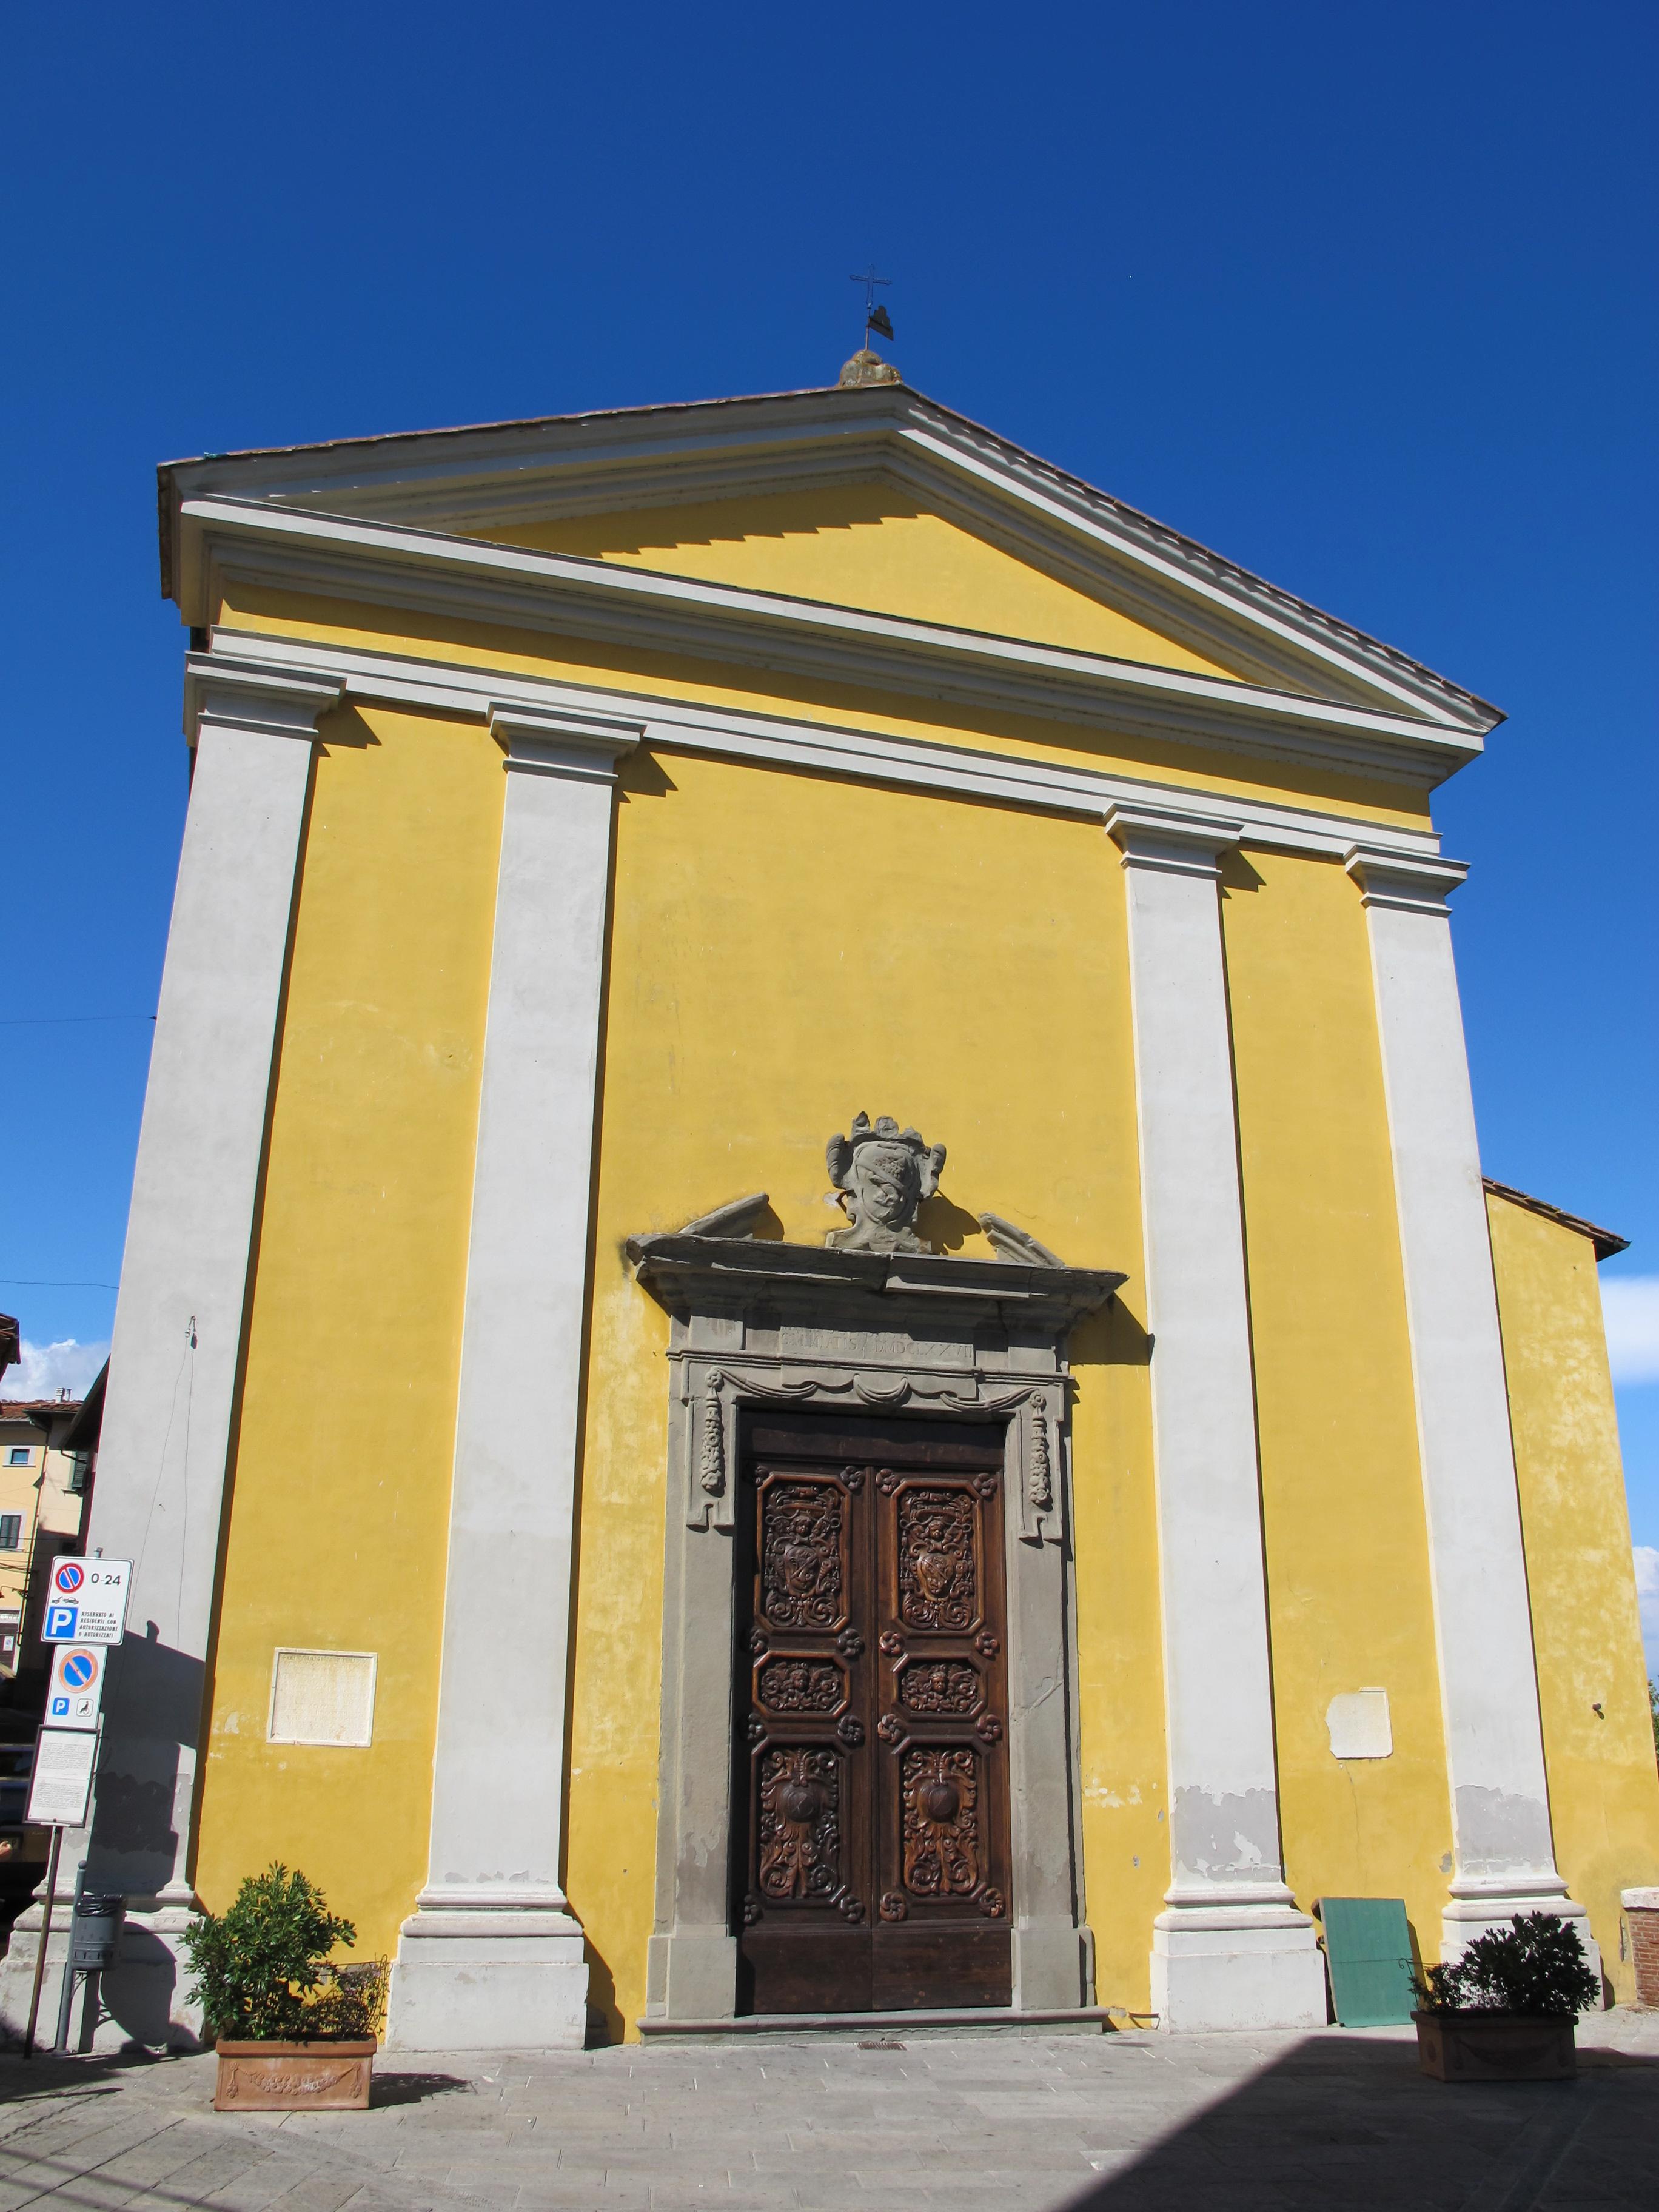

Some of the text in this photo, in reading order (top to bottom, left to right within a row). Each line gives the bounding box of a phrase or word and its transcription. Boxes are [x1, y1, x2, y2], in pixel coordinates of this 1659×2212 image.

[91, 1573, 121, 1586] 0-24
[51, 1609, 72, 1635] P
[56, 1700, 66, 1713] P
